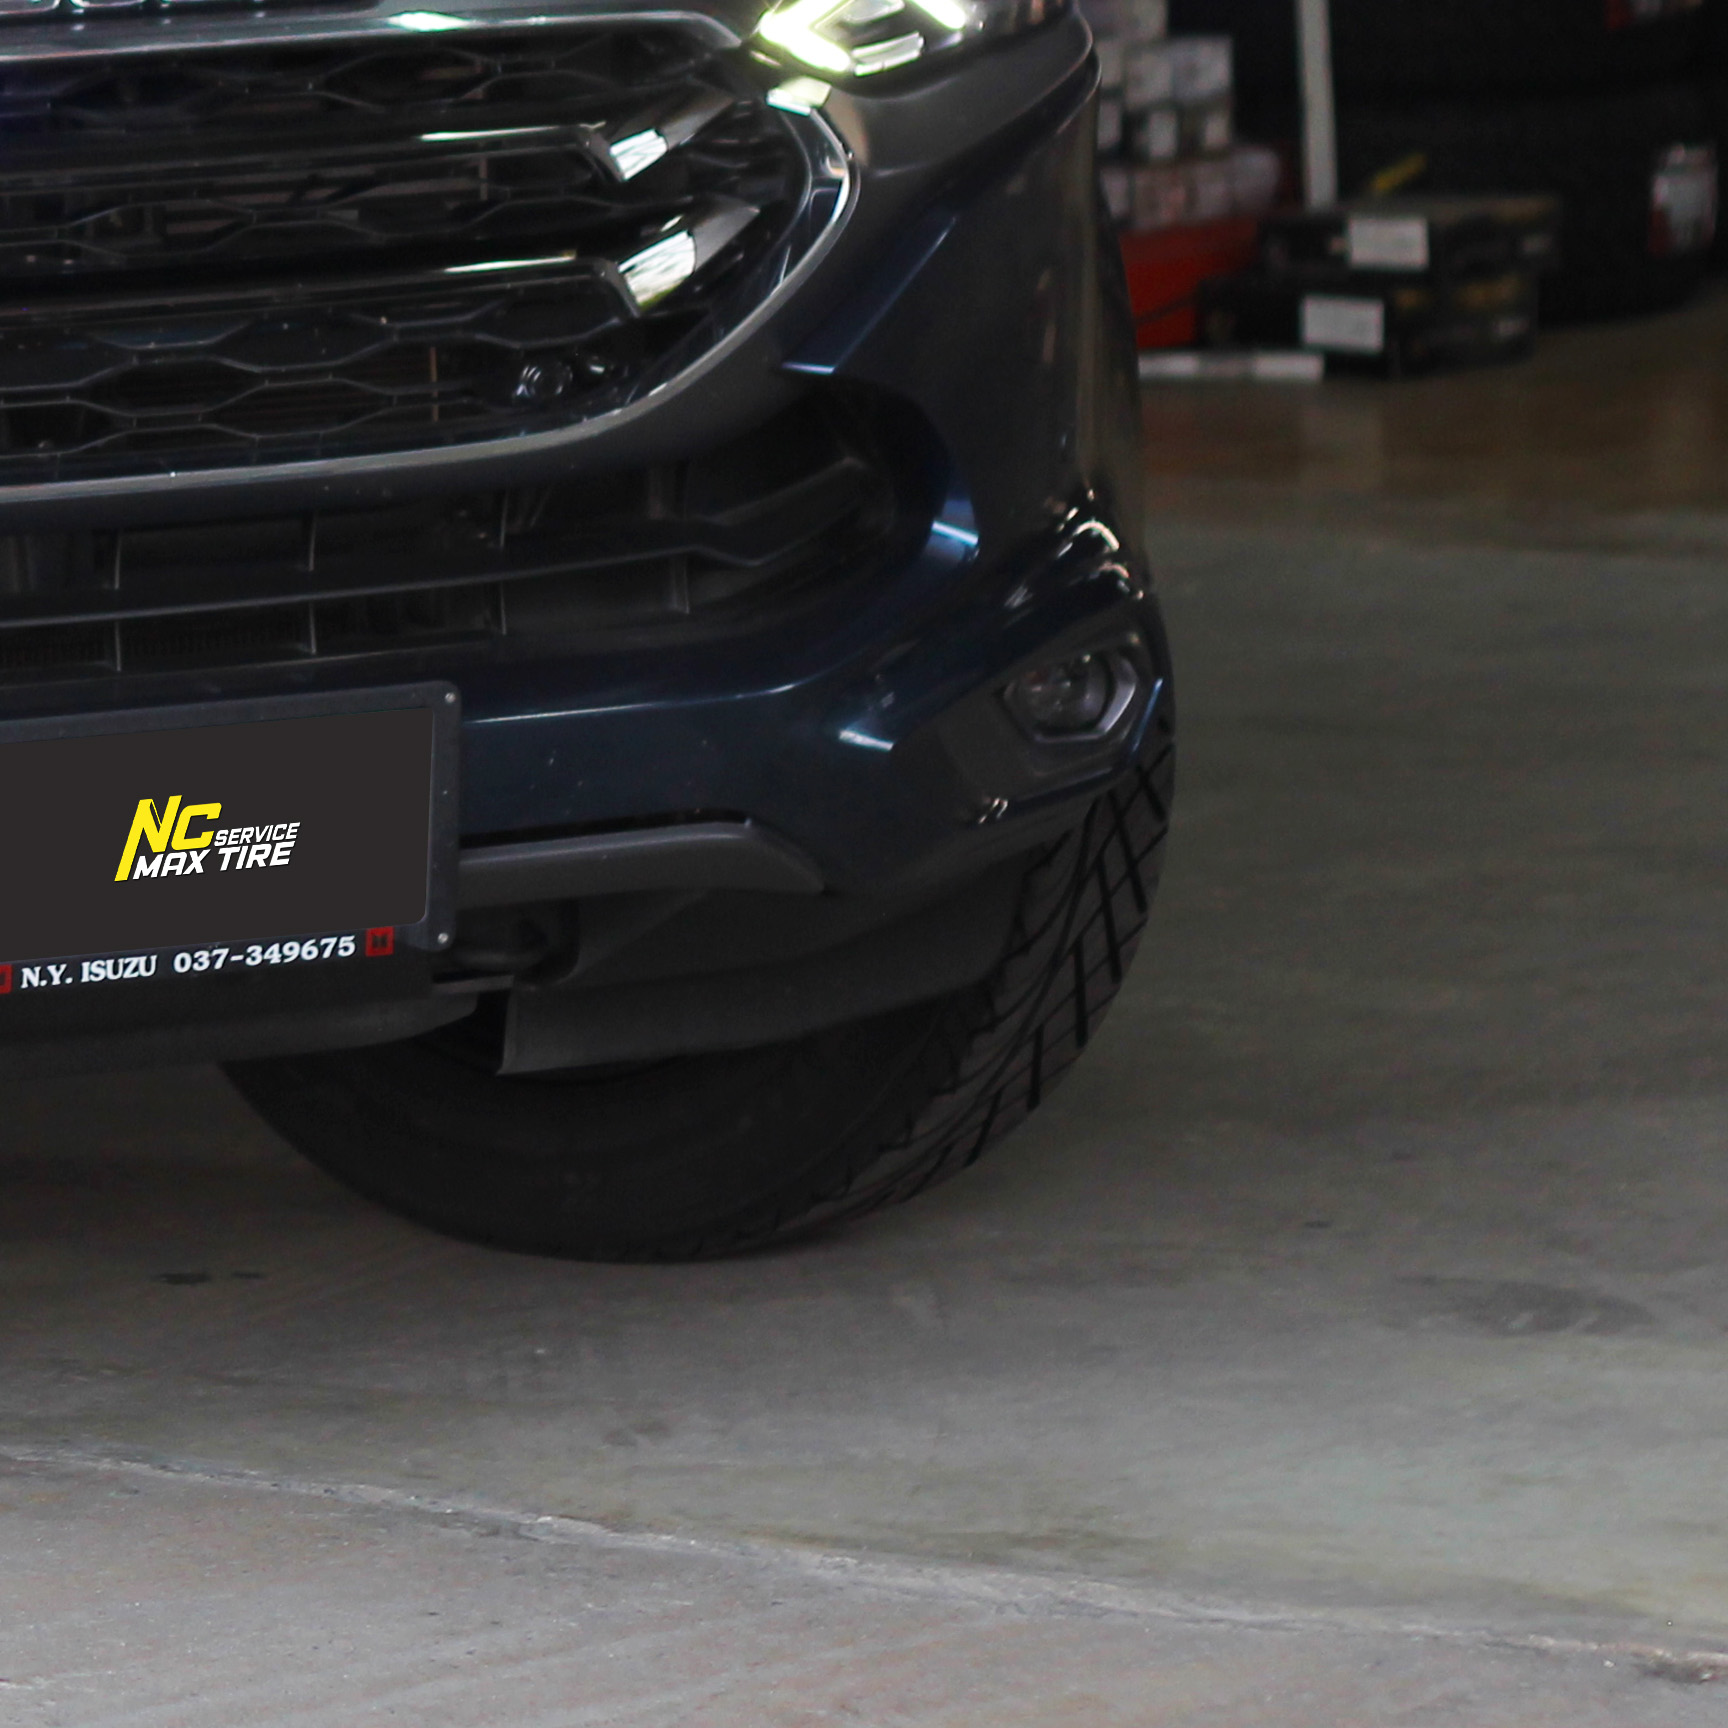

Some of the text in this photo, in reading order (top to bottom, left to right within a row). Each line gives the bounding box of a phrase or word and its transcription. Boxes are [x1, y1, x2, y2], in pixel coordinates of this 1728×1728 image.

[20, 934, 356, 989] N.Y. ISUZU 037-349675
